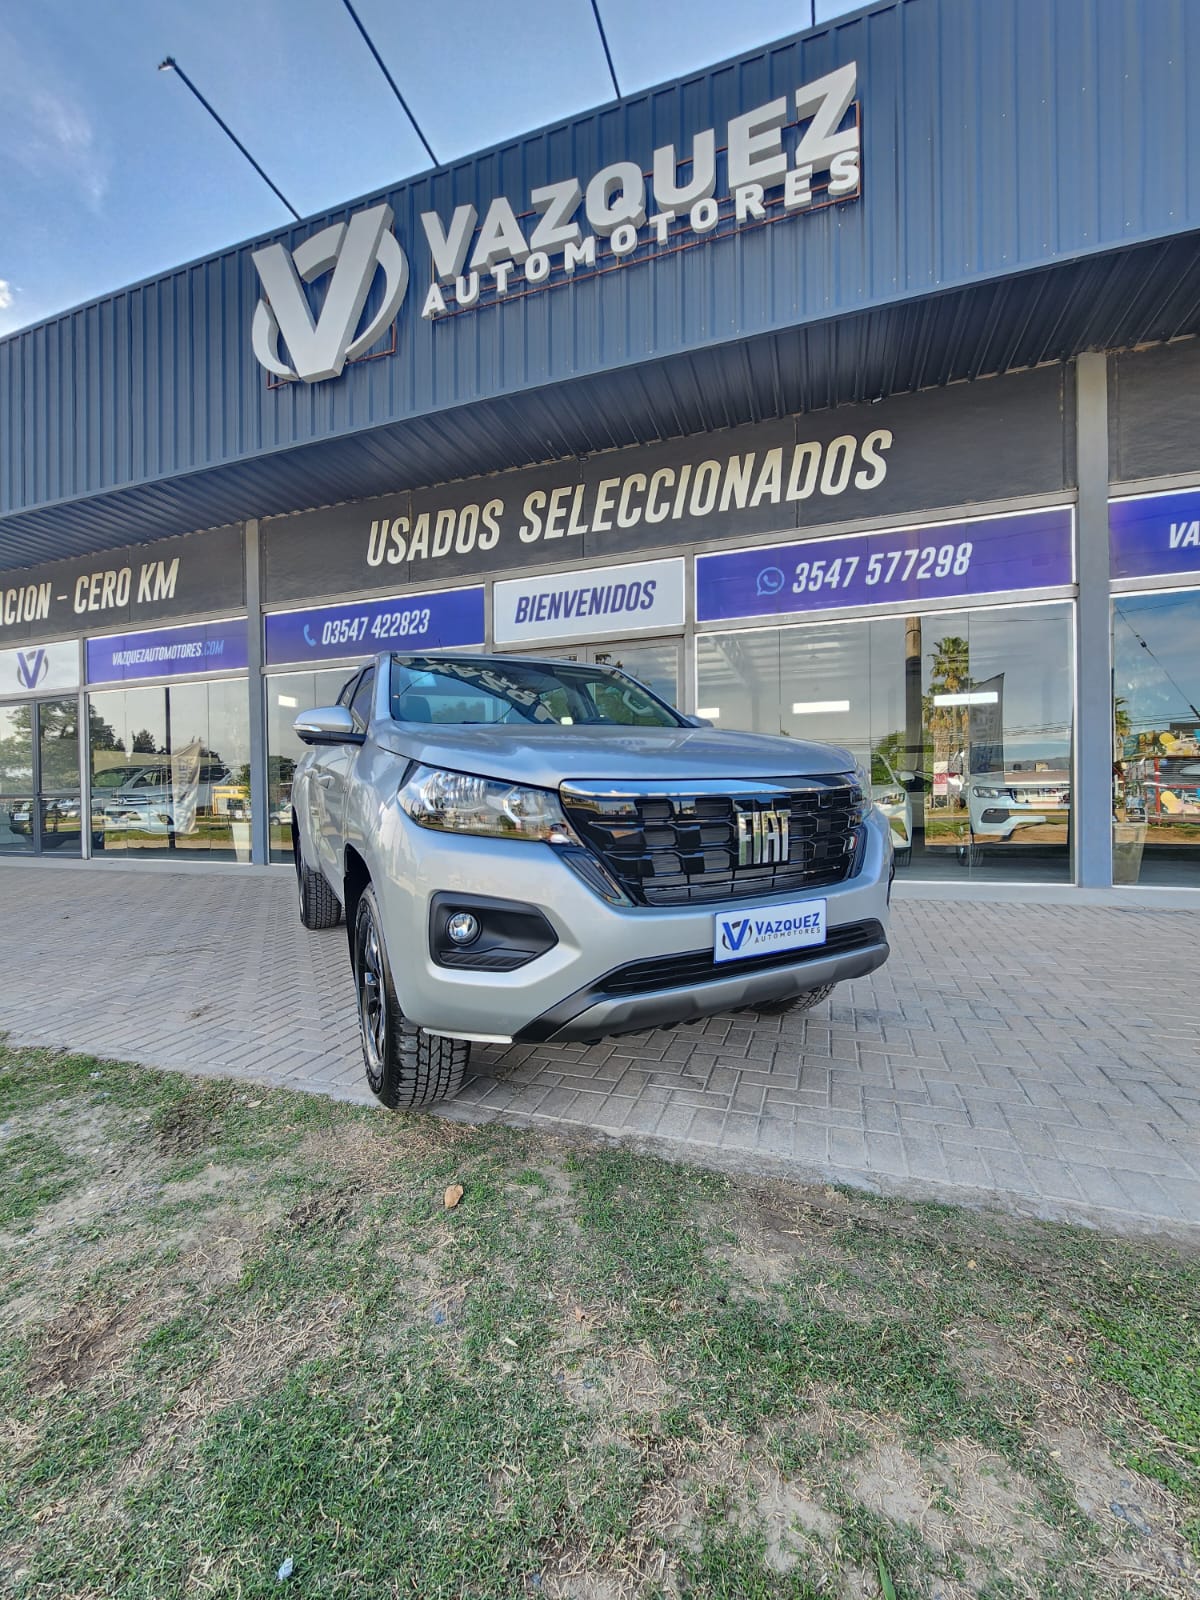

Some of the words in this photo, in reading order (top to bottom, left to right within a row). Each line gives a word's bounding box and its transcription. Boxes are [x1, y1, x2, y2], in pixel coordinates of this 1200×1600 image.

[420, 61, 858, 286] VAZQUEZ
[421, 150, 860, 319] AUTOMOTORES
[366, 498, 505, 567] USADOS
[519, 429, 894, 544] SELECCIONADOS
[1169, 520, 1200, 549] VA
[73, 567, 132, 614] CERO
[137, 558, 180, 603] KM
[792, 556, 858, 593] 3547
[864, 542, 973, 586] 577298
[514, 580, 656, 624] BIENVENIDOS
[321, 617, 369, 646] 03547
[370, 608, 431, 639] 422823
[111, 639, 225, 667] VAZQUEZAUTOMOTORES.COM
[738, 809, 790, 865] FIAT
[754, 926, 821, 945] AUTOMOTORES
[755, 912, 820, 935] VAZQUEZ
